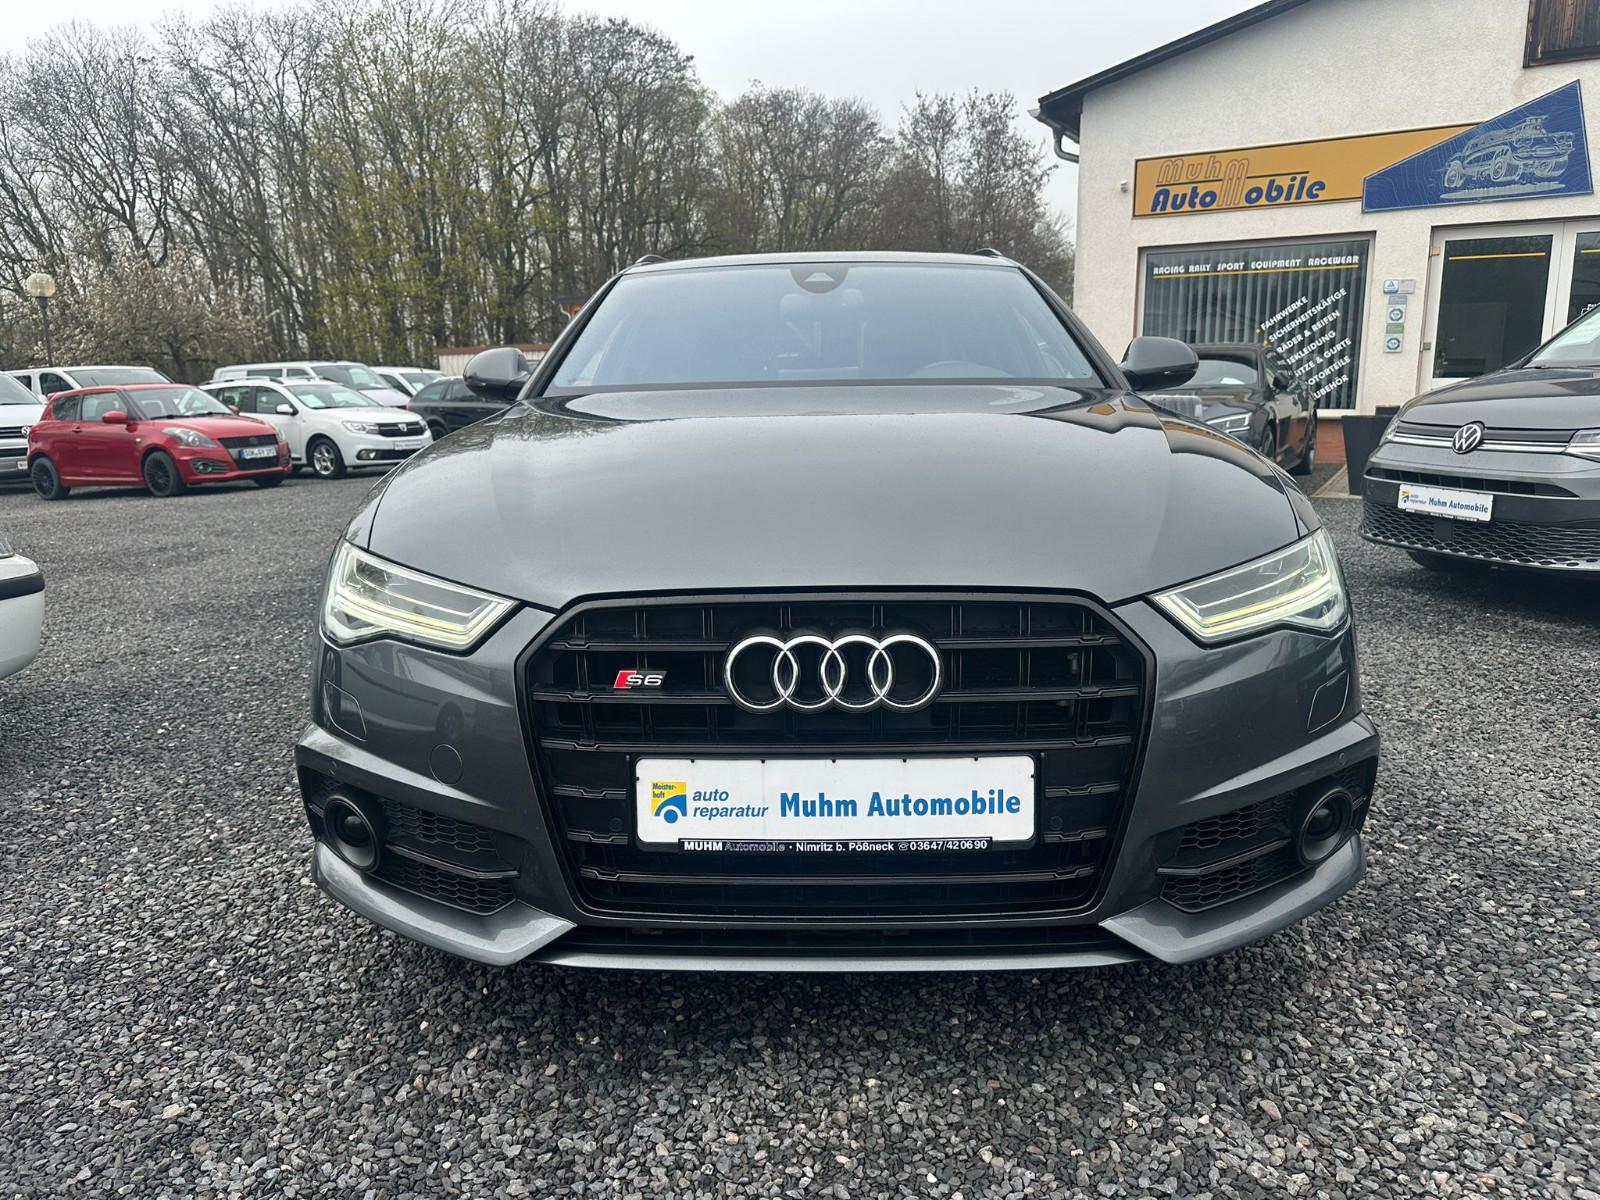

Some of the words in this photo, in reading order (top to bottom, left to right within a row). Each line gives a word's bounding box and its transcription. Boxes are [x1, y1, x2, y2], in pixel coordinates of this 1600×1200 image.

[1153, 265, 1185, 275] RACING
[1189, 263, 1211, 273] RALLY
[1217, 262, 1245, 272] SPORT
[1250, 259, 1301, 270] EQUIPMENT
[1308, 255, 1359, 266] RACEWEAR
[1260, 295, 1309, 331] FAHRWERKE
[1268, 287, 1348, 343] SICHERHEITSKÄFIGE
[1276, 334, 1303, 354] RÄDER
[1304, 329, 1312, 338] &
[1311, 309, 1340, 332] REIFEN
[1315, 356, 1322, 364] &
[1323, 337, 1352, 359] GURTE
[1306, 355, 1351, 386] OTORTEILE
[1313, 374, 1349, 400] UBEHÖR
[1428, 497, 1447, 507] Muhm
[1449, 500, 1488, 513] Automobile
[625, 674, 663, 686] S6
[692, 789, 729, 802] auto
[780, 792, 858, 817] Muhm
[867, 789, 1021, 817] Automobile
[693, 804, 769, 821] reparatur
[684, 841, 723, 851] MUHM
[724, 841, 786, 852] Automobile
[796, 841, 834, 852] Nimritz
[836, 841, 846, 851] b.
[848, 840, 895, 851] Pößneck
